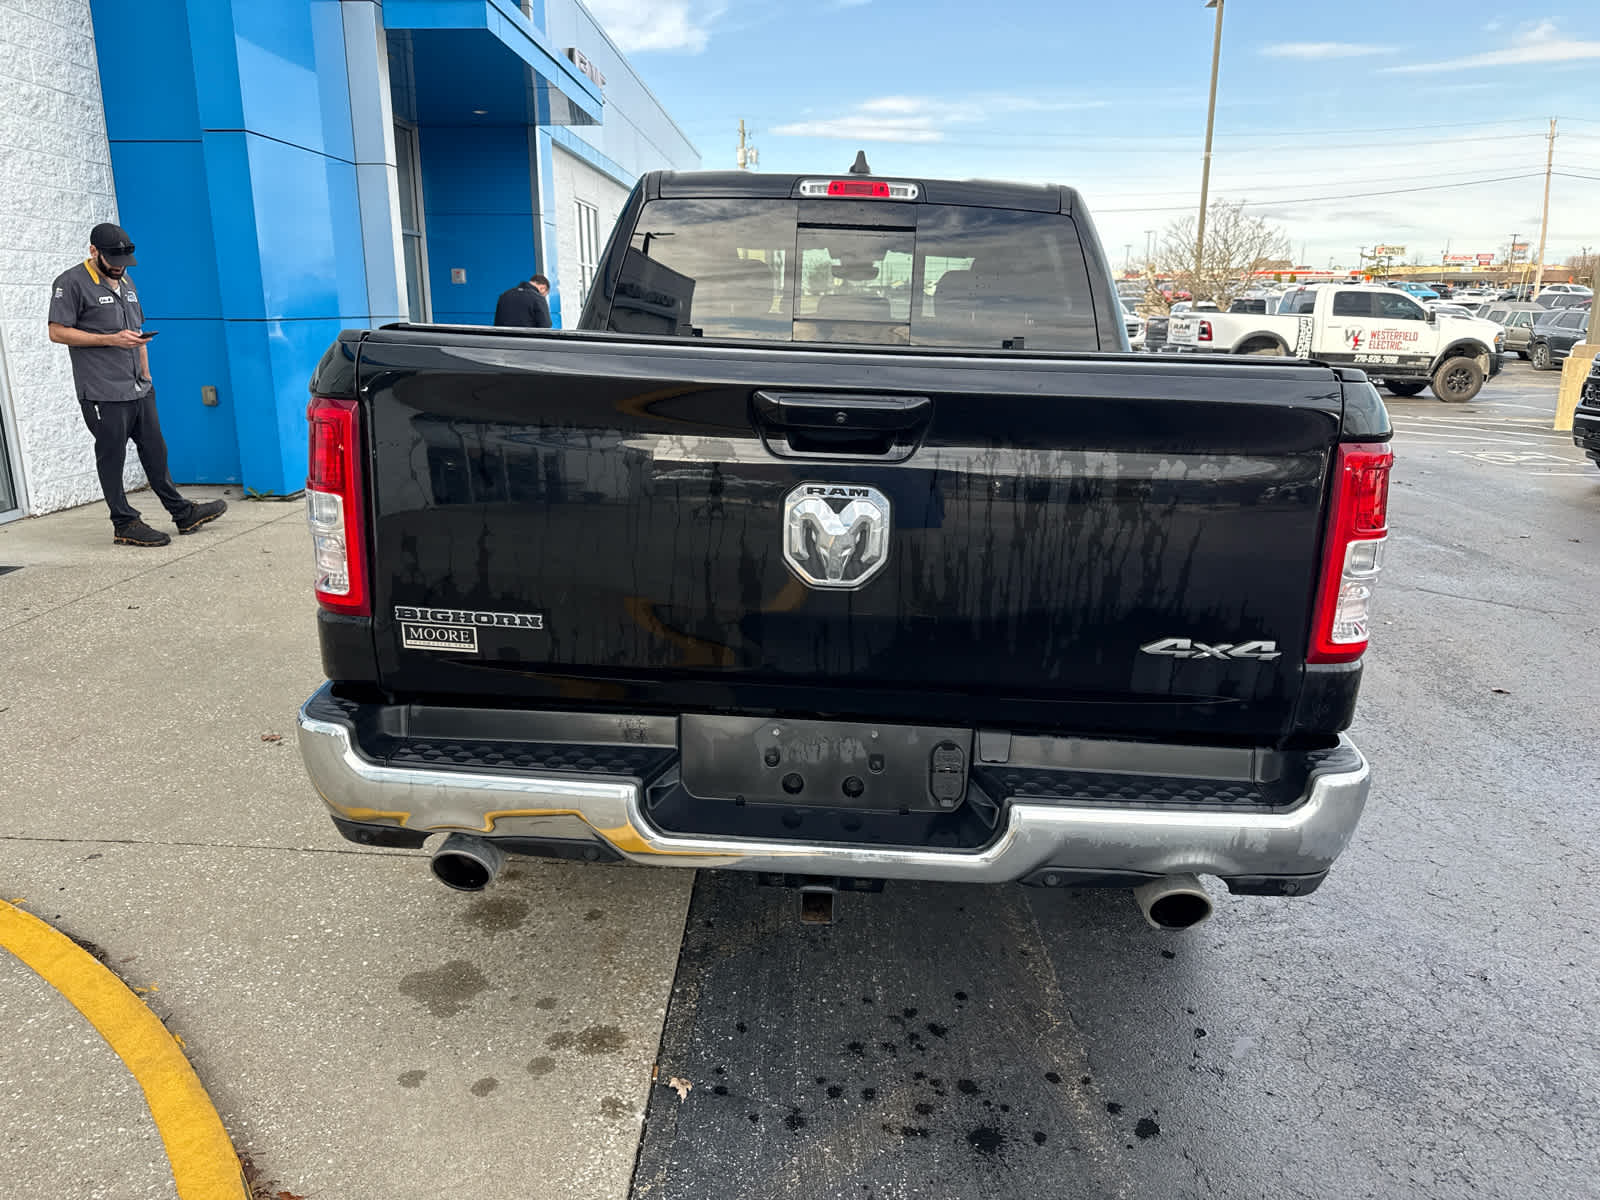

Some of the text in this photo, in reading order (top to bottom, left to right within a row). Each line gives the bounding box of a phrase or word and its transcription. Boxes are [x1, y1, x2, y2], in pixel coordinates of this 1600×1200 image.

[1371, 330, 1418, 341] WESTERFIELD
[1368, 340, 1402, 351] ELECTRIC
[806, 487, 869, 497] RAM
[395, 606, 543, 629] BIGHORN
[409, 627, 471, 642] MOORE
